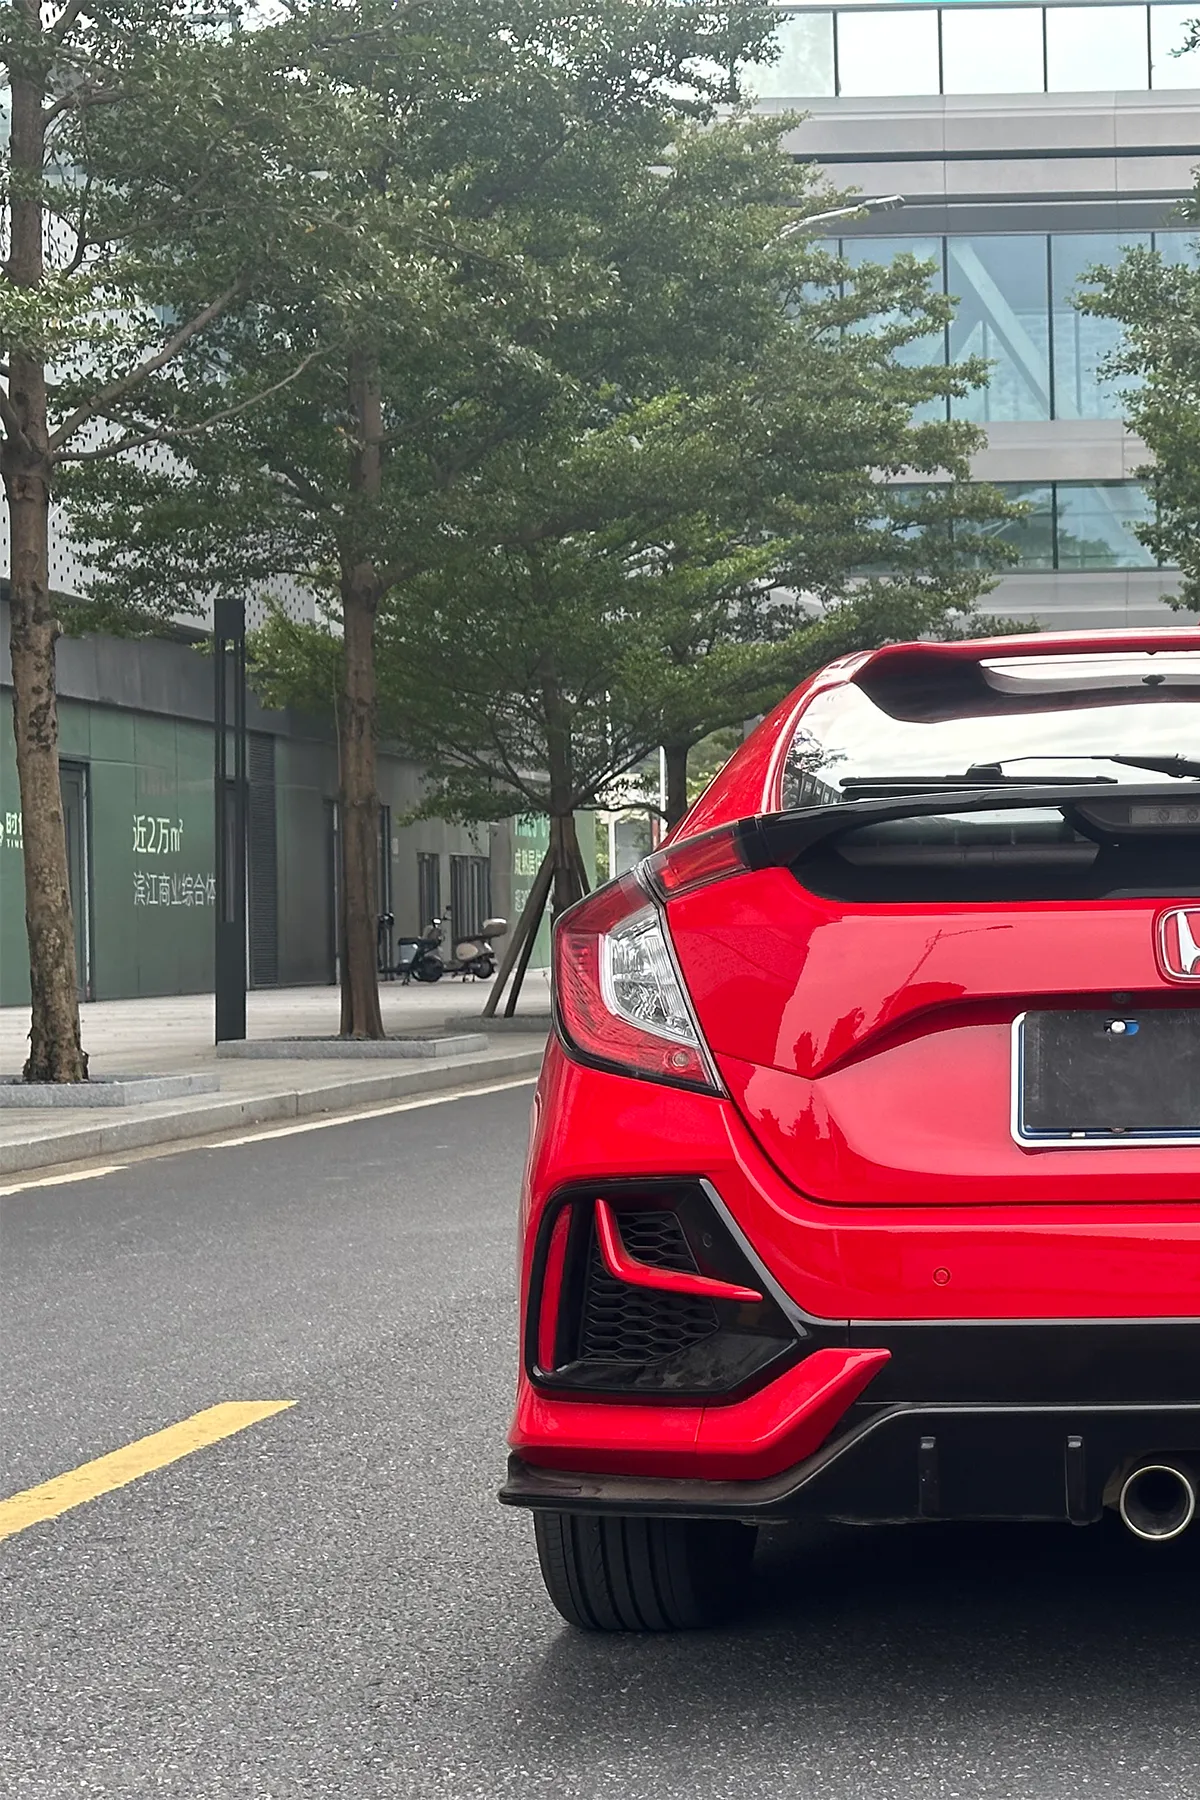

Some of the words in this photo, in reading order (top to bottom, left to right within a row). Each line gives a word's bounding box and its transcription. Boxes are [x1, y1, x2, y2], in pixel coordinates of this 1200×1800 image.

[133, 870, 216, 906] 滨江商业综合体
